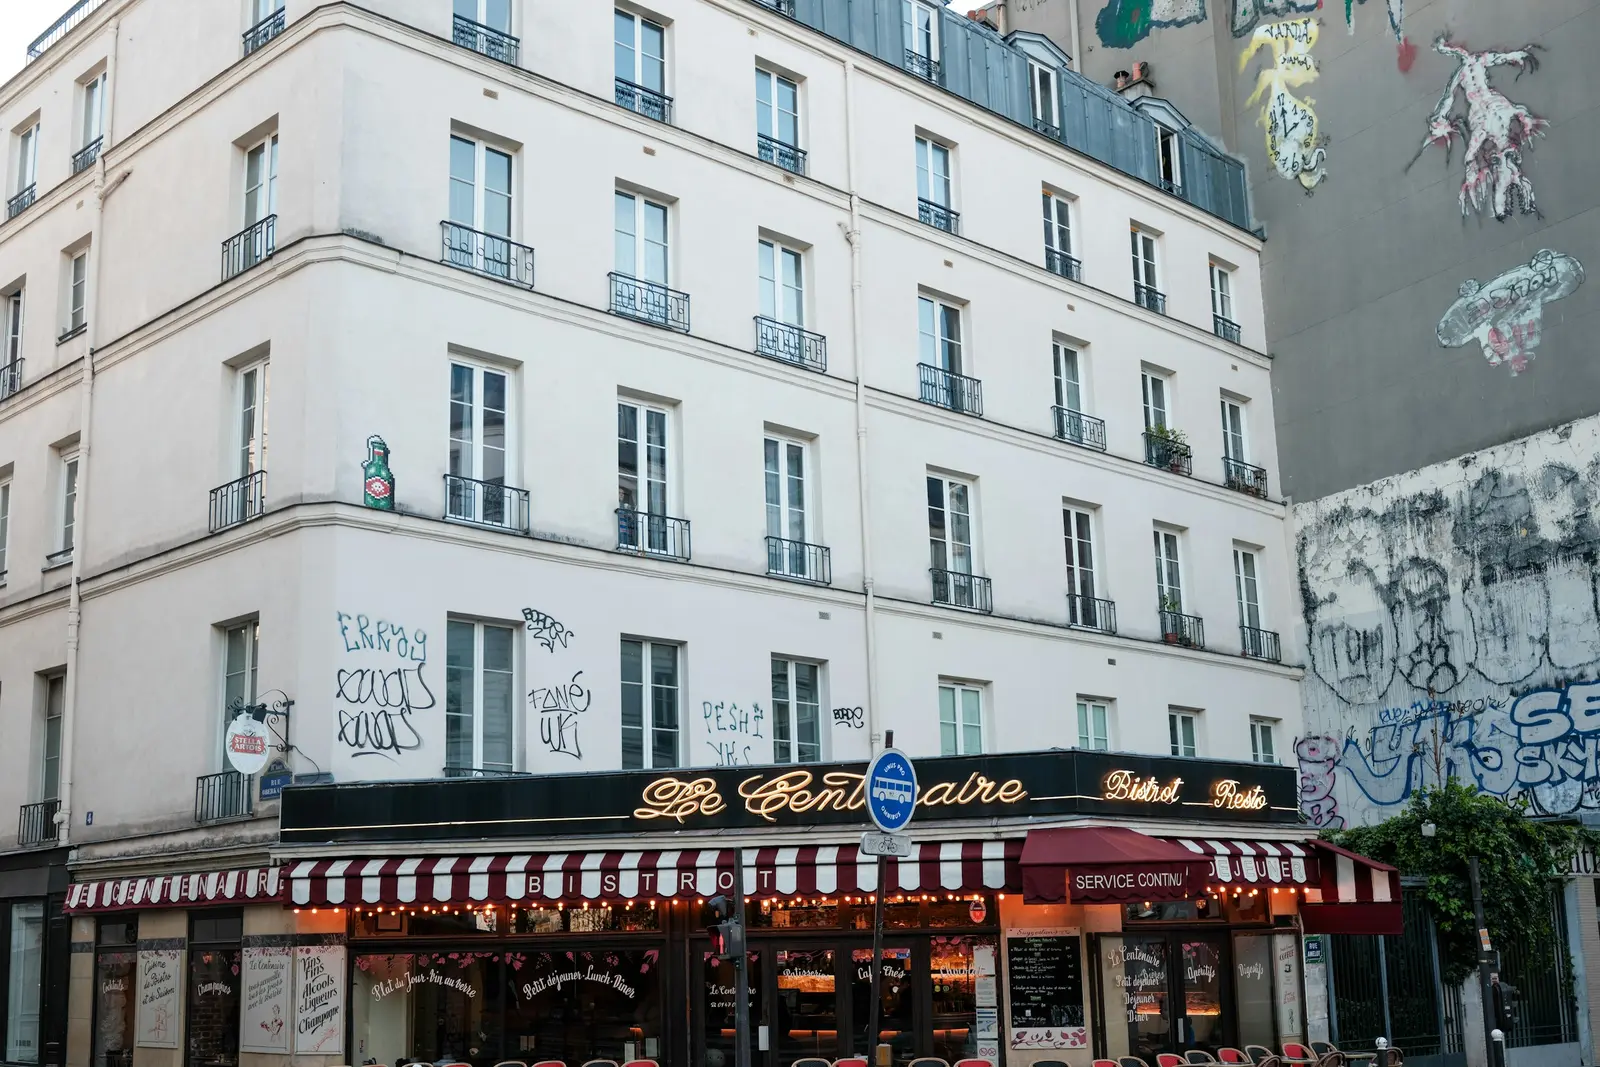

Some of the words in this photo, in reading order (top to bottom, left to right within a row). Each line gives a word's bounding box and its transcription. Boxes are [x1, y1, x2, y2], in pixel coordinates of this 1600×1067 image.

[234, 736, 262, 746] STELLA
[234, 743, 262, 752] ARTOIS
[883, 761, 897, 773] UNUS
[897, 764, 906, 776] PRO
[633, 776, 729, 825] Le
[737, 770, 1028, 824] Centaire
[1104, 769, 1185, 805] Bistrot
[1213, 778, 1268, 810] Resto
[880, 805, 902, 820] OMNIBUS
[65, 886, 89, 904] LE
[112, 872, 284, 902] CENTENAIRE
[528, 869, 780, 893] BISTROT
[1076, 873, 1135, 890] SERVICE
[1137, 872, 1183, 887] CONTINU
[301, 956, 321, 973] Vins
[1118, 945, 1160, 968] Centenaire
[302, 974, 335, 999] Alcools
[371, 979, 395, 1002] Plat
[394, 977, 405, 989] du
[403, 971, 427, 993] Jour
[444, 976, 455, 987] au
[522, 977, 547, 1000] Petit
[546, 970, 583, 991] déjeuner
[584, 964, 610, 985] Lunch
[612, 974, 636, 999] Dîner
[857, 965, 874, 984] Caf
[304, 988, 338, 1012] Liqueurs
[298, 1005, 340, 1034] Champagne
